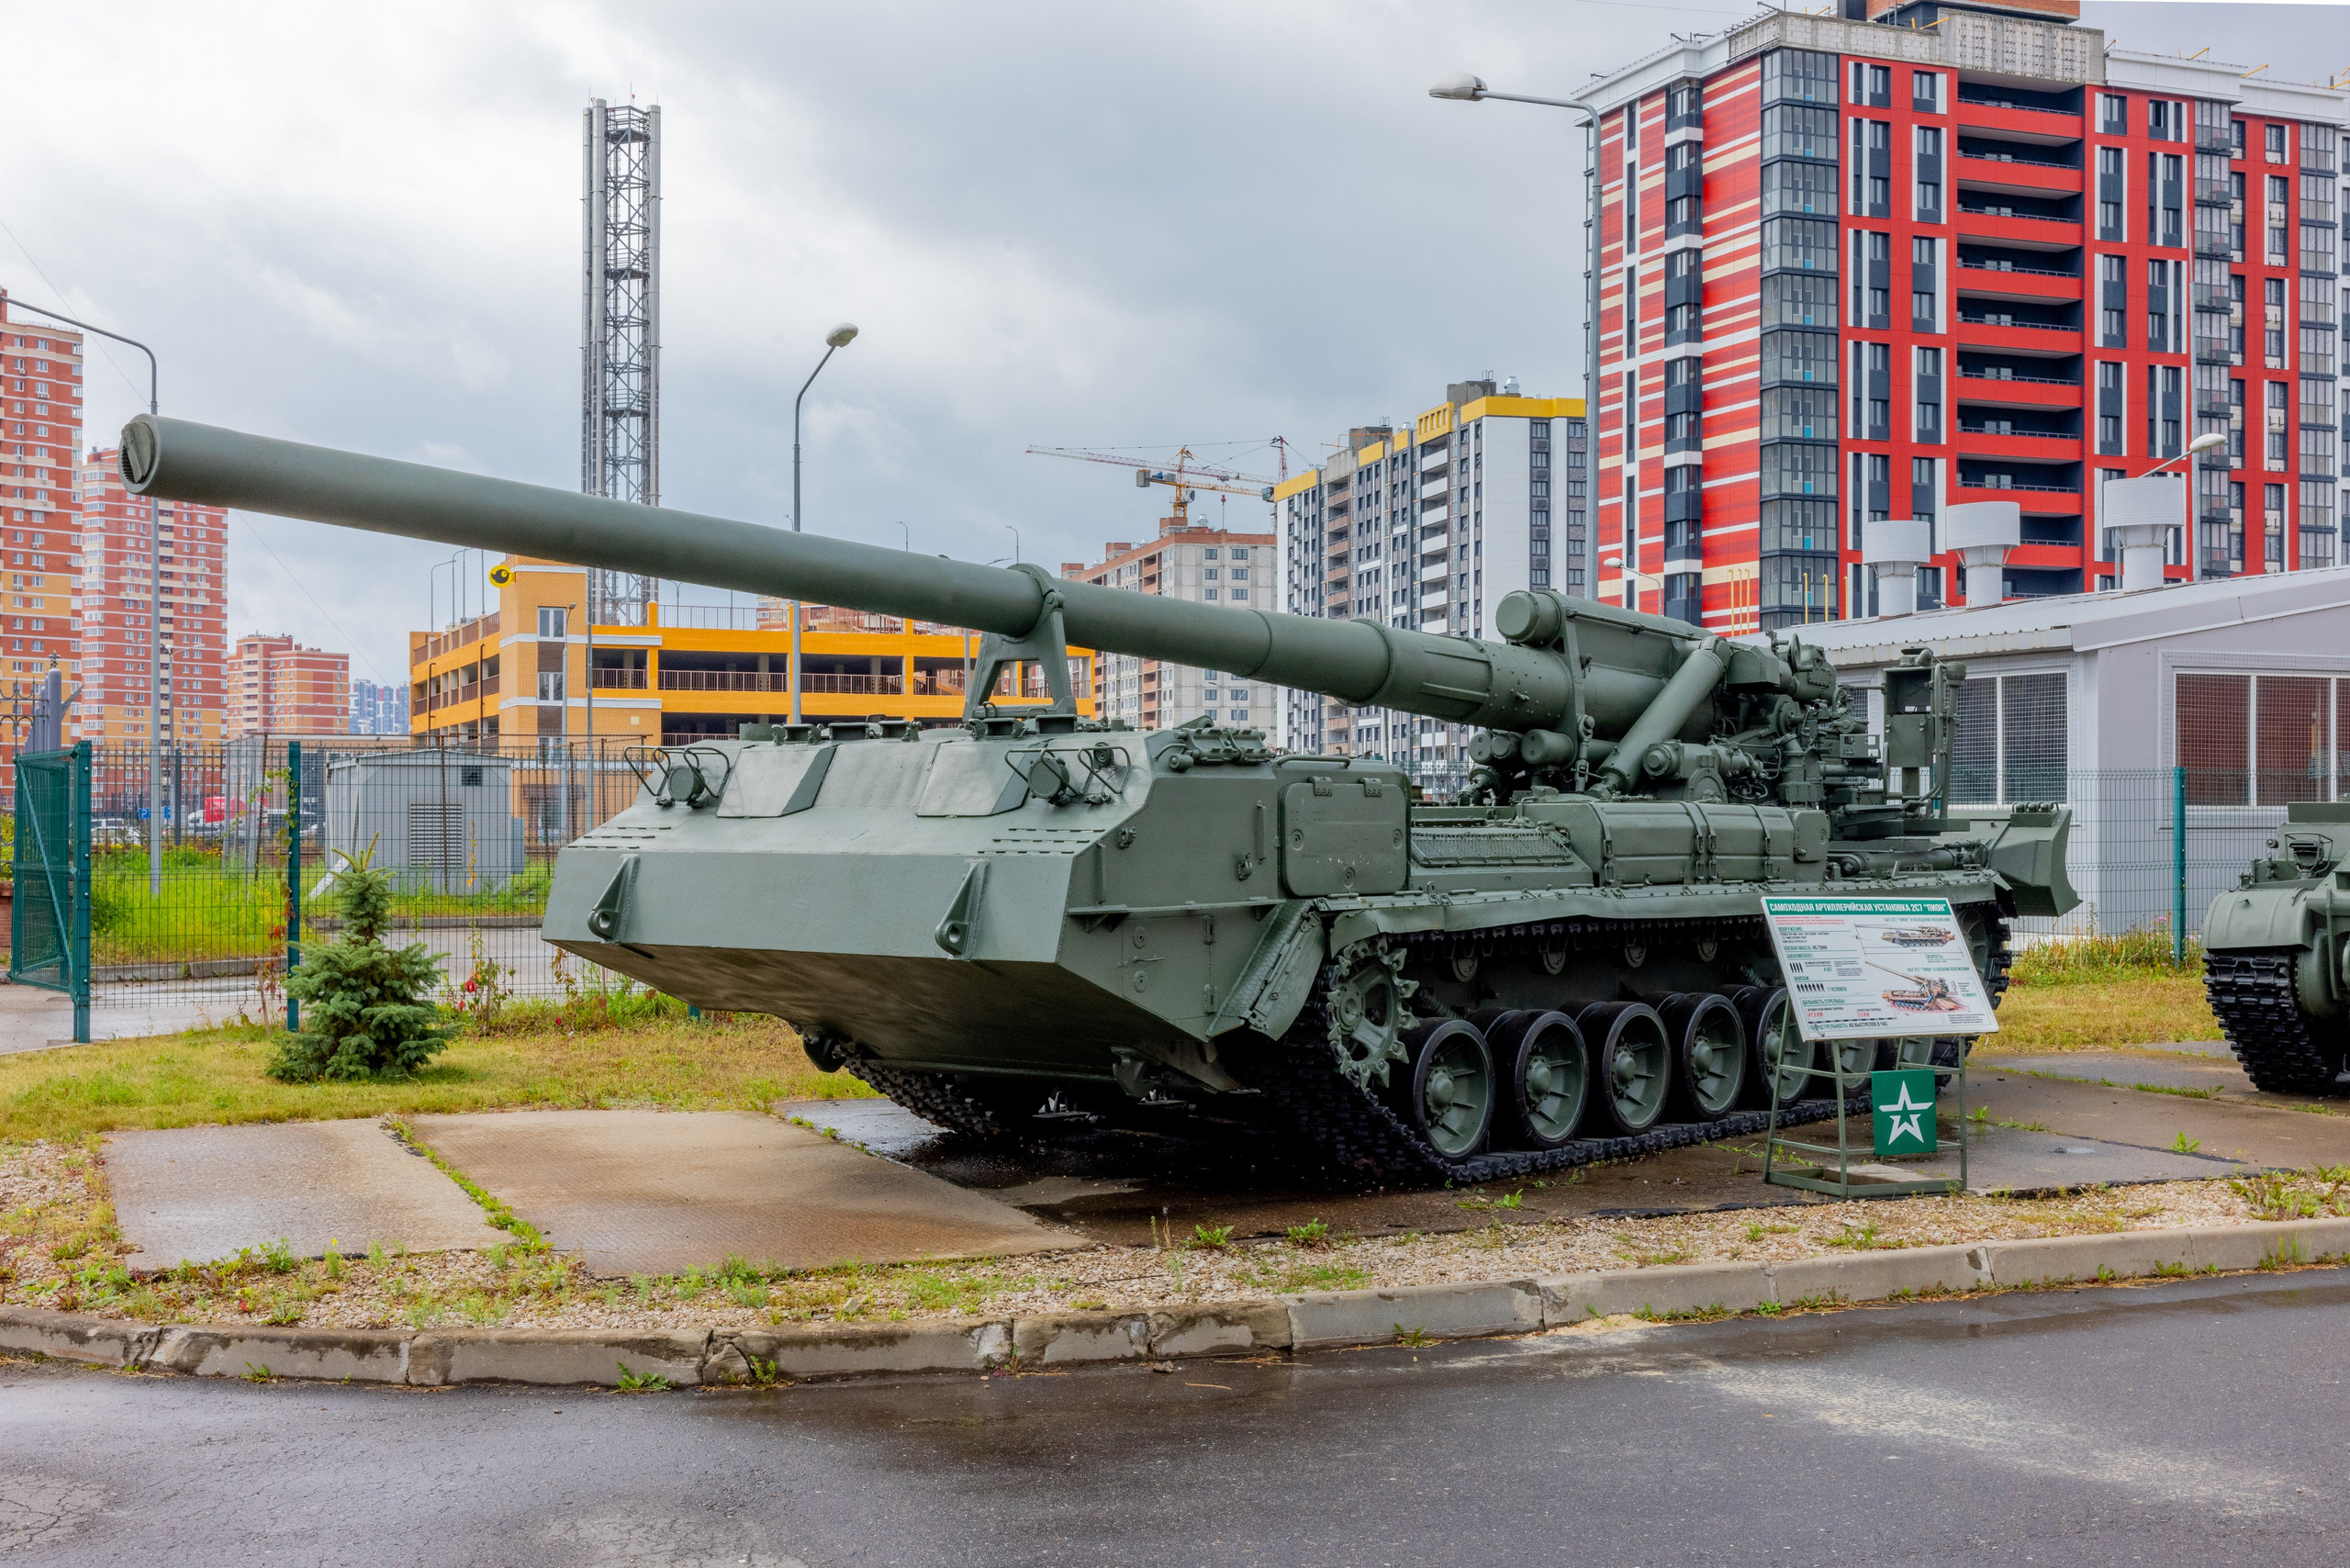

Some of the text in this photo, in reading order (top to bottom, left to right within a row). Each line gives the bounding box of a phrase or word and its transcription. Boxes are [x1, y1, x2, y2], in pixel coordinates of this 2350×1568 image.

[1769, 902, 1946, 912] САМОХОДНАЯ АРТИЛЛЕРИЙСКАЯ УСТАНОВКА 2С7 "ПИОН"
